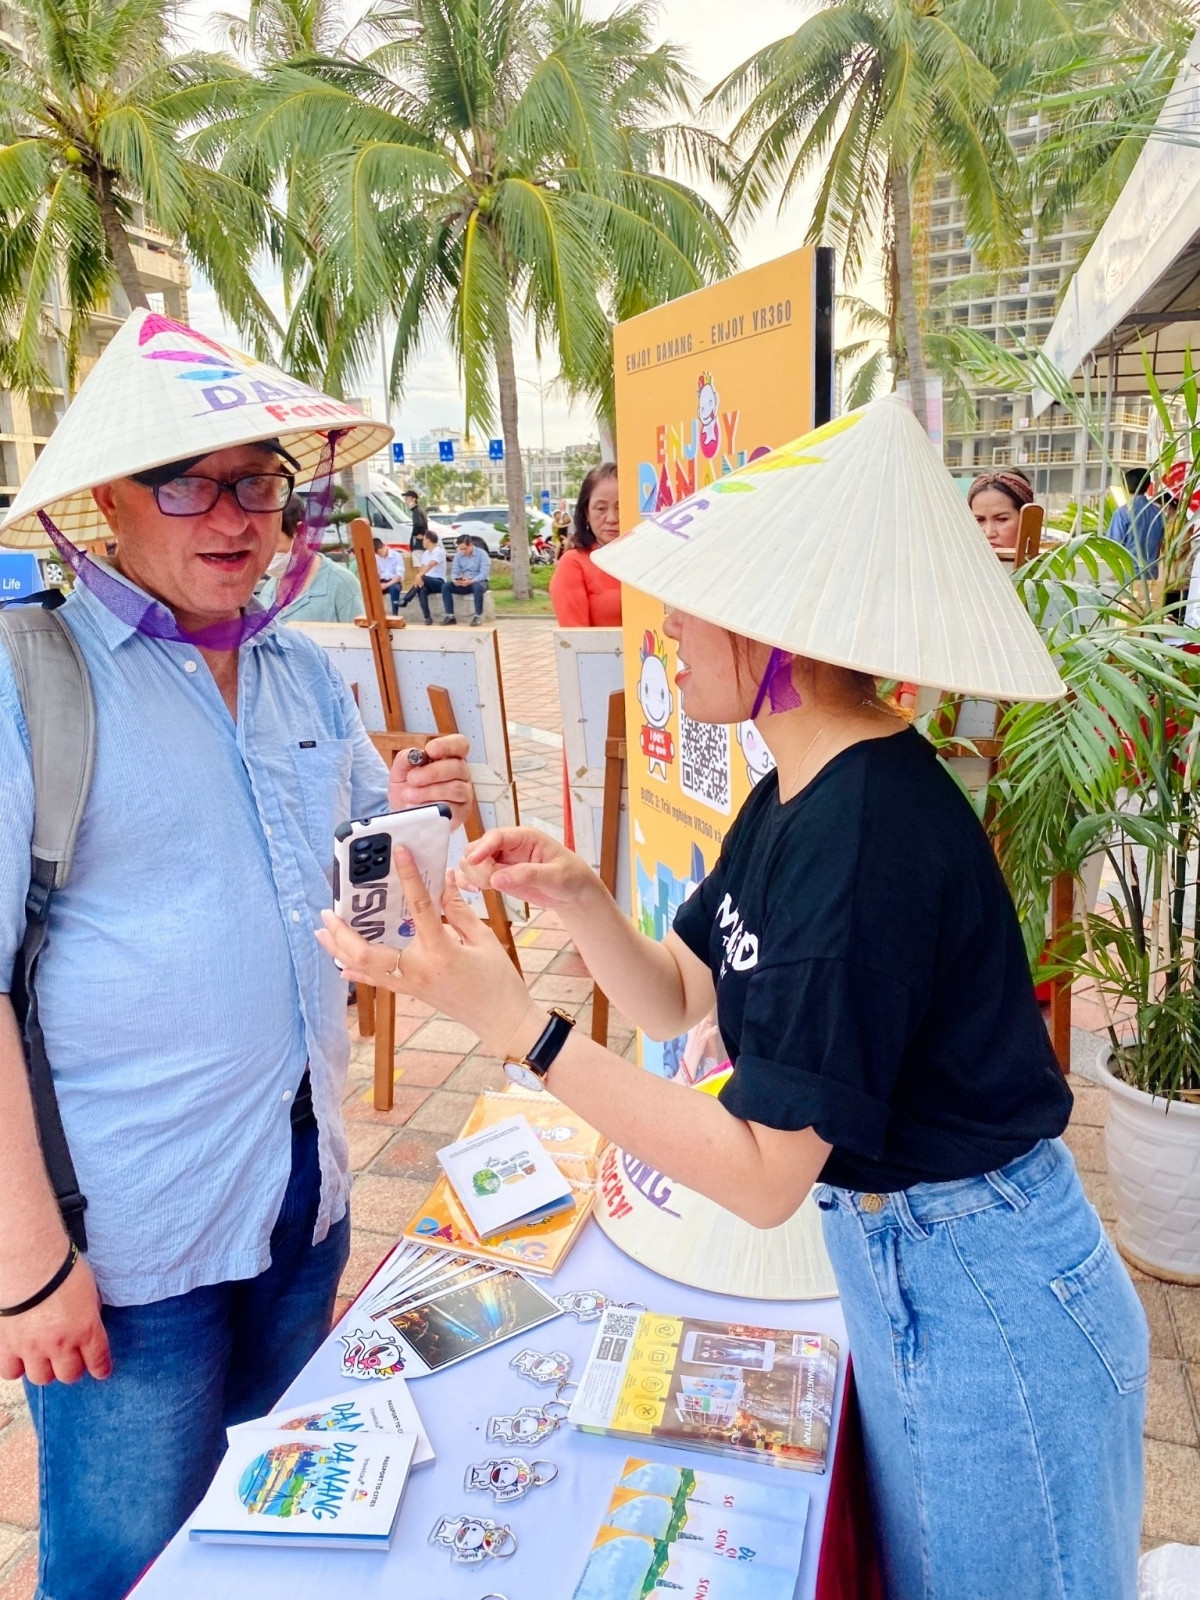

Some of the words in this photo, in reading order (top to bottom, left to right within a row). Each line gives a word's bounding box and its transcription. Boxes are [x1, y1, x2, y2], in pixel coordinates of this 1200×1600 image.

[626, 347, 651, 372] ENJOY
[656, 333, 693, 363] DANANG
[711, 315, 745, 345] ENJOY
[752, 299, 792, 332] VR360
[656, 410, 741, 465] ENJOY
[2, 578, 21, 590] Life
[693, 815, 713, 839] VR360
[332, 1442, 358, 1464] DA
[378, 1455, 391, 1483] PASSPORT
[312, 1466, 351, 1520] NANG
[375, 1481, 382, 1490] TO
[369, 1490, 379, 1508] CITIES
